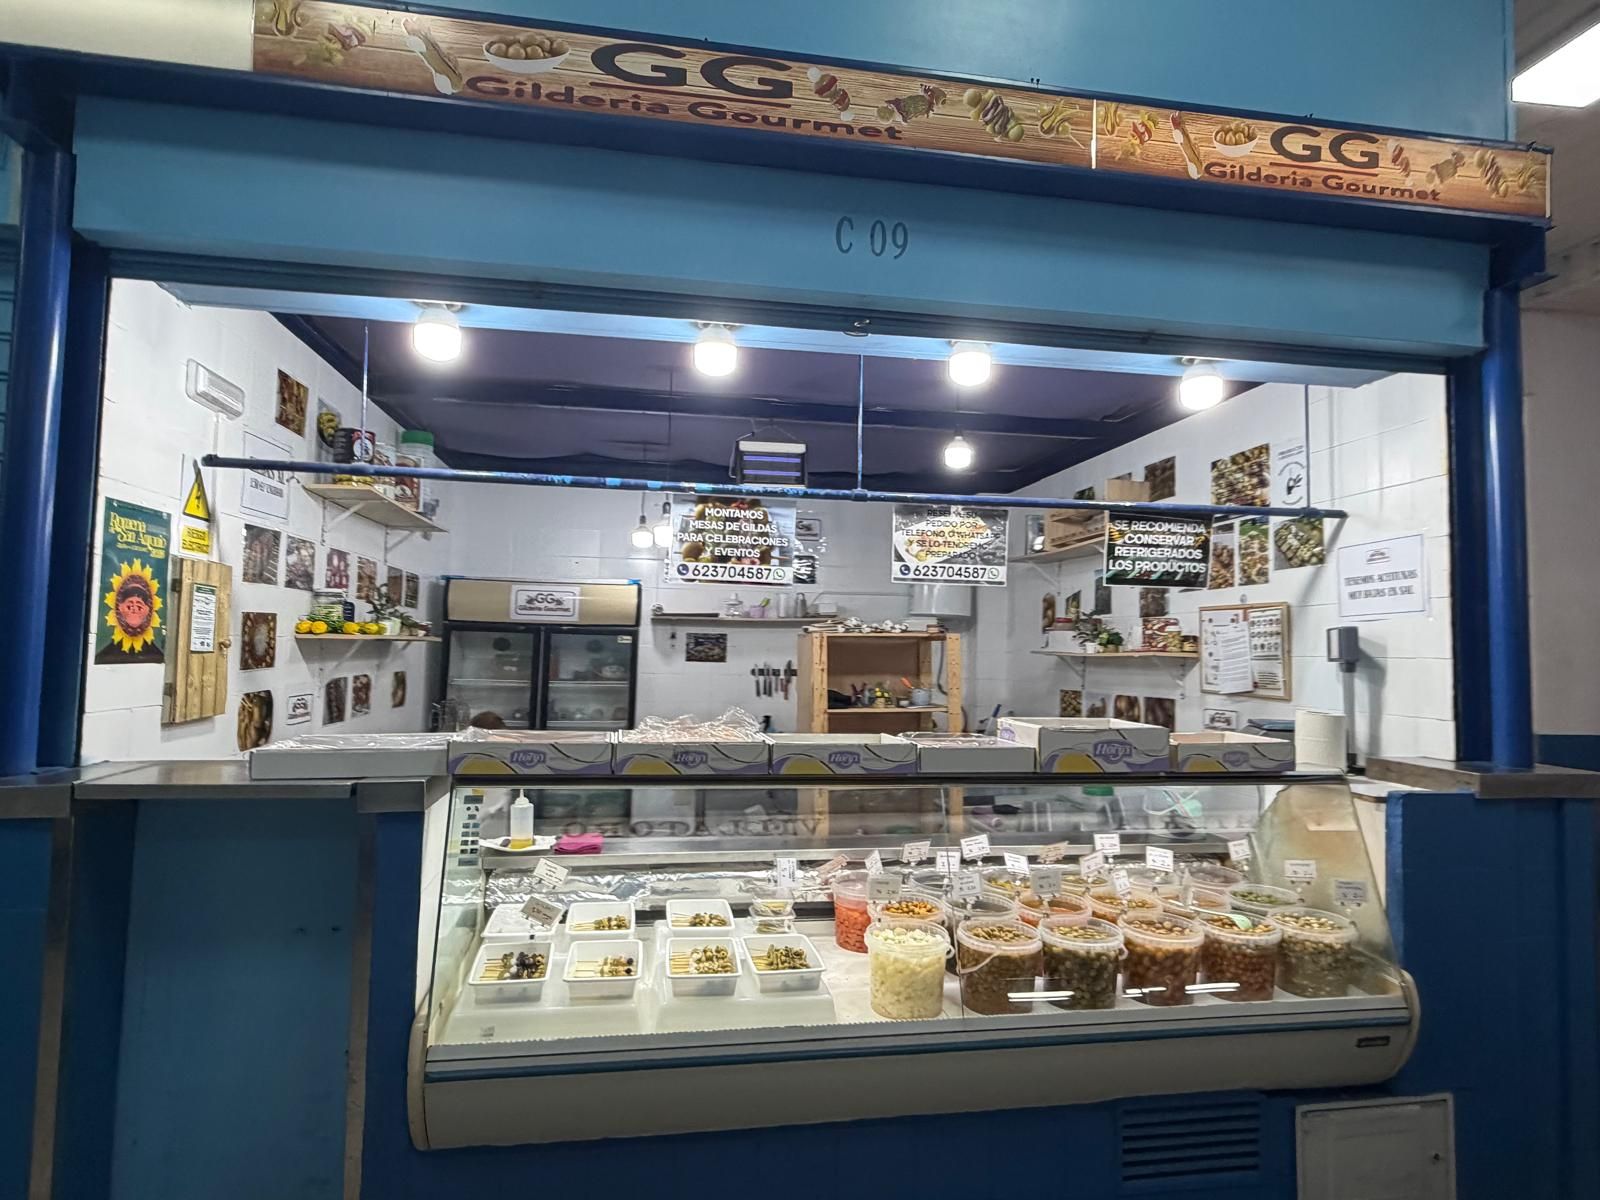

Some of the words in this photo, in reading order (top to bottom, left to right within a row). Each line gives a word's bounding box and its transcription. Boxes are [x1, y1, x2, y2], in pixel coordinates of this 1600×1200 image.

[591, 43, 793, 99] GG
[466, 76, 670, 114] Gilderia
[687, 101, 903, 141] Gourmet
[1270, 126, 1379, 169] GG
[1204, 161, 1313, 188] Gilderia
[1321, 174, 1442, 202] Gourmet
[836, 215, 854, 254] C
[870, 220, 909, 260] 09
[704, 507, 764, 519] MONTAMOS
[689, 519, 724, 531] MESAS
[725, 521, 740, 531] DE
[741, 523, 778, 533] GILDAS
[926, 519, 957, 528] PEDIDO
[959, 521, 978, 529] POR
[1114, 520, 1130, 530] SE
[1131, 521, 1207, 533] RECOMIENDA
[676, 532, 704, 542] PARA
[705, 534, 789, 547] CELEBRACIONES
[916, 539, 928, 548] SE
[928, 540, 941, 548] LO
[1124, 533, 1195, 546] CONSERVAR
[705, 546, 713, 555] Y
[714, 547, 761, 558] EVENTOS
[925, 550, 977, 560] PREPARADO
[1114, 546, 1203, 559] REFRIGERADOS
[691, 564, 772, 580] 623704587
[913, 565, 987, 579] 623704587
[1109, 559, 1133, 571] LOS
[1134, 561, 1208, 573] PRODUCTOS
[536, 593, 556, 604] GG
